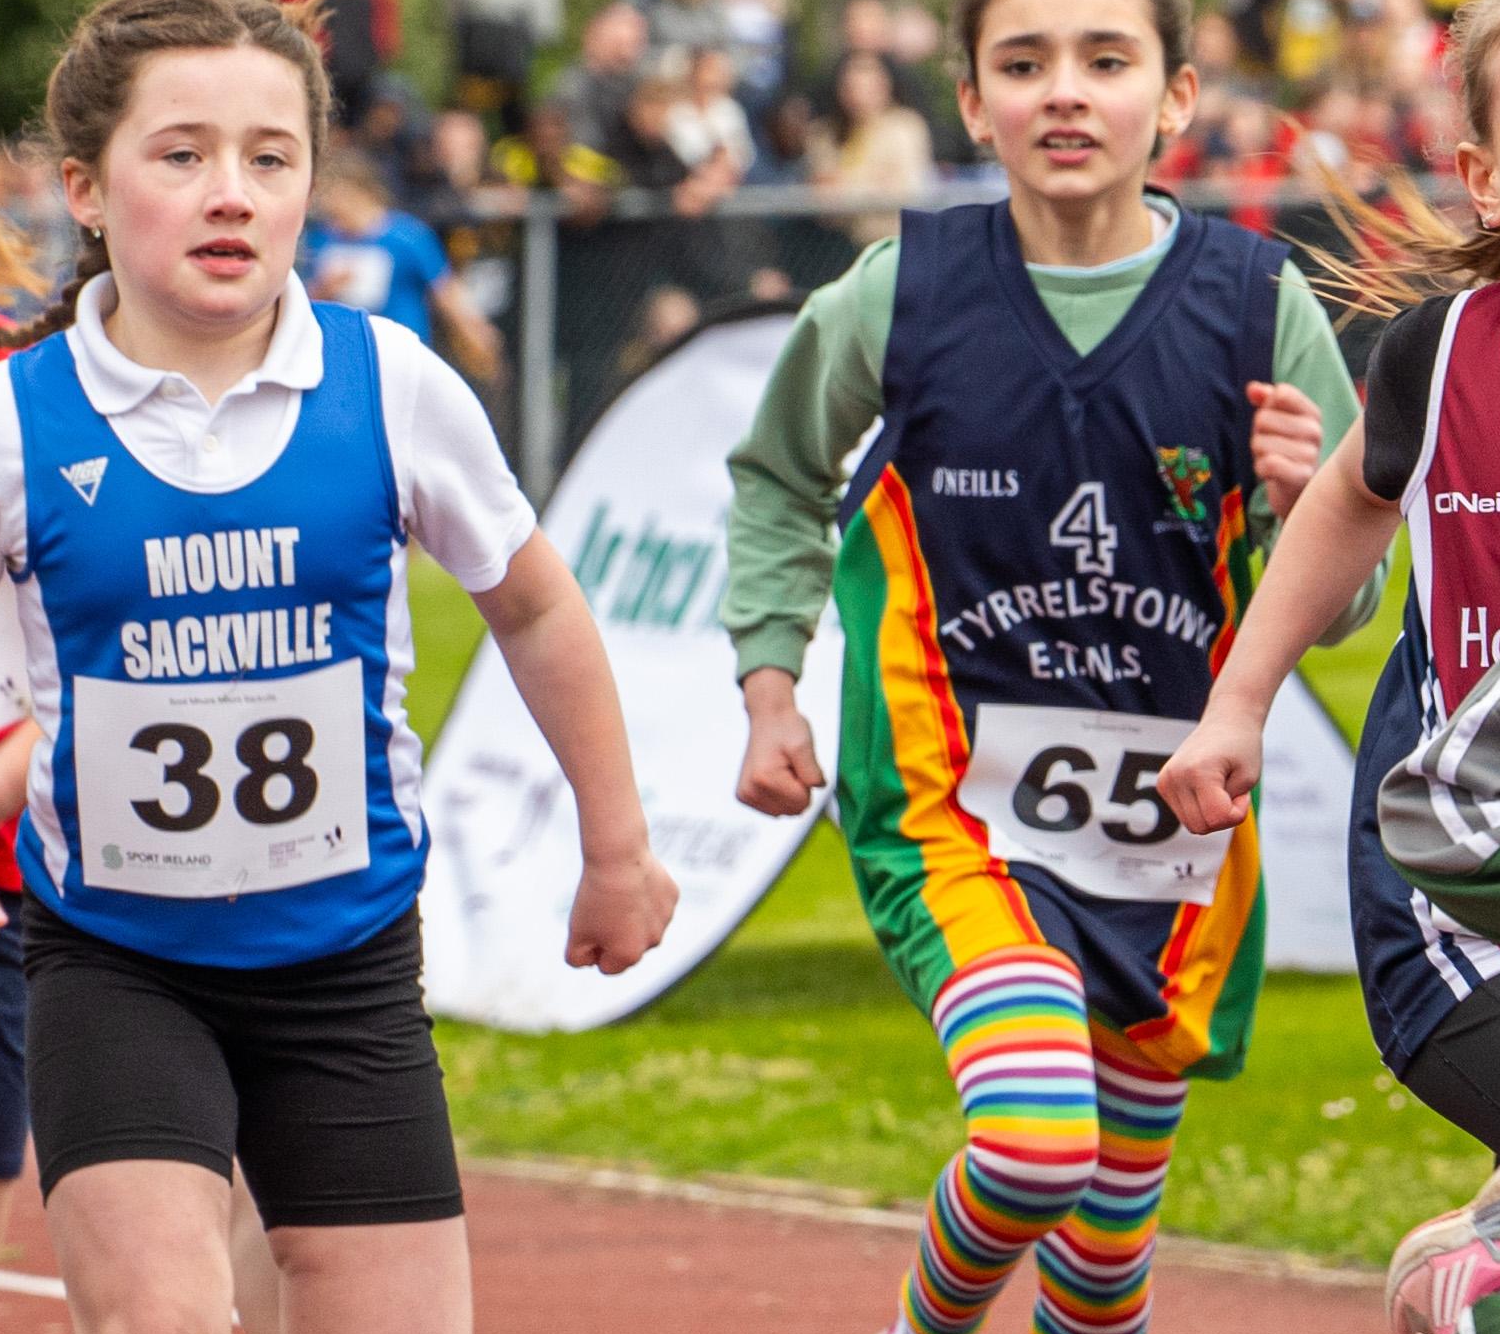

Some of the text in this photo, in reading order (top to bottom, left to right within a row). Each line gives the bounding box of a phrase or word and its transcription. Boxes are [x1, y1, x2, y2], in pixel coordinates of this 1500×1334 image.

[144, 527, 300, 598] MOUNT
[1049, 481, 1118, 577] 4
[121, 603, 333, 680] SACKVILLE
[1028, 641, 1151, 684] E.T.N.S.
[129, 717, 319, 833] 38
[1012, 745, 1181, 845] 65
[125, 851, 212, 865] SPORT IRELAND
